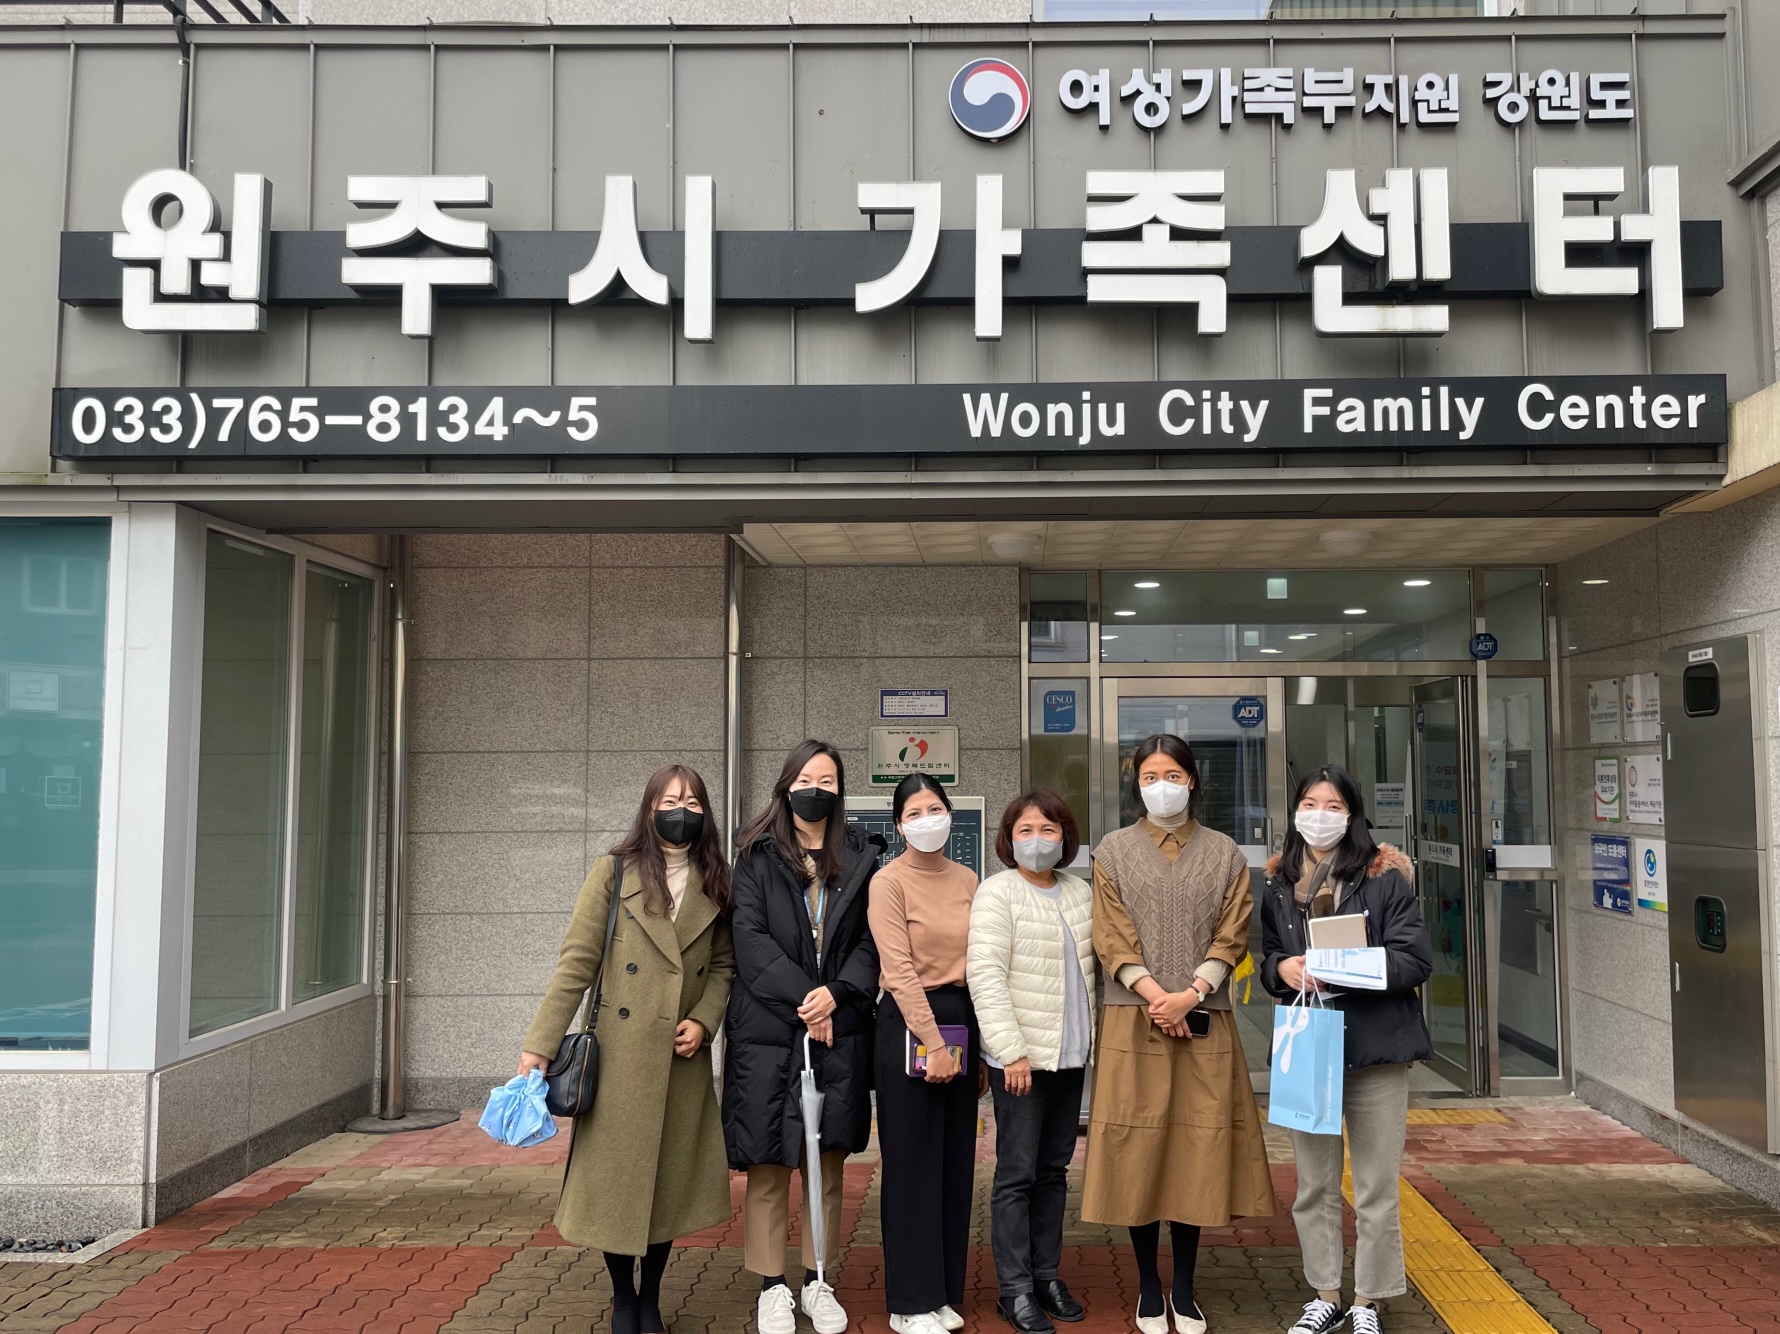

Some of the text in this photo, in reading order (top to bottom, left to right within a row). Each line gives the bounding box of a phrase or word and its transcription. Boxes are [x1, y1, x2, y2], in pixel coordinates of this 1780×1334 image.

[1058, 67, 1636, 129] 여성가족부지원 강원도
[112, 165, 1685, 343] 원주시 가족센터
[962, 383, 1707, 447] Wonju City Family Center
[1476, 641, 1494, 651] ADT
[1046, 694, 1073, 705] CESCO
[1238, 706, 1260, 718] ADT
